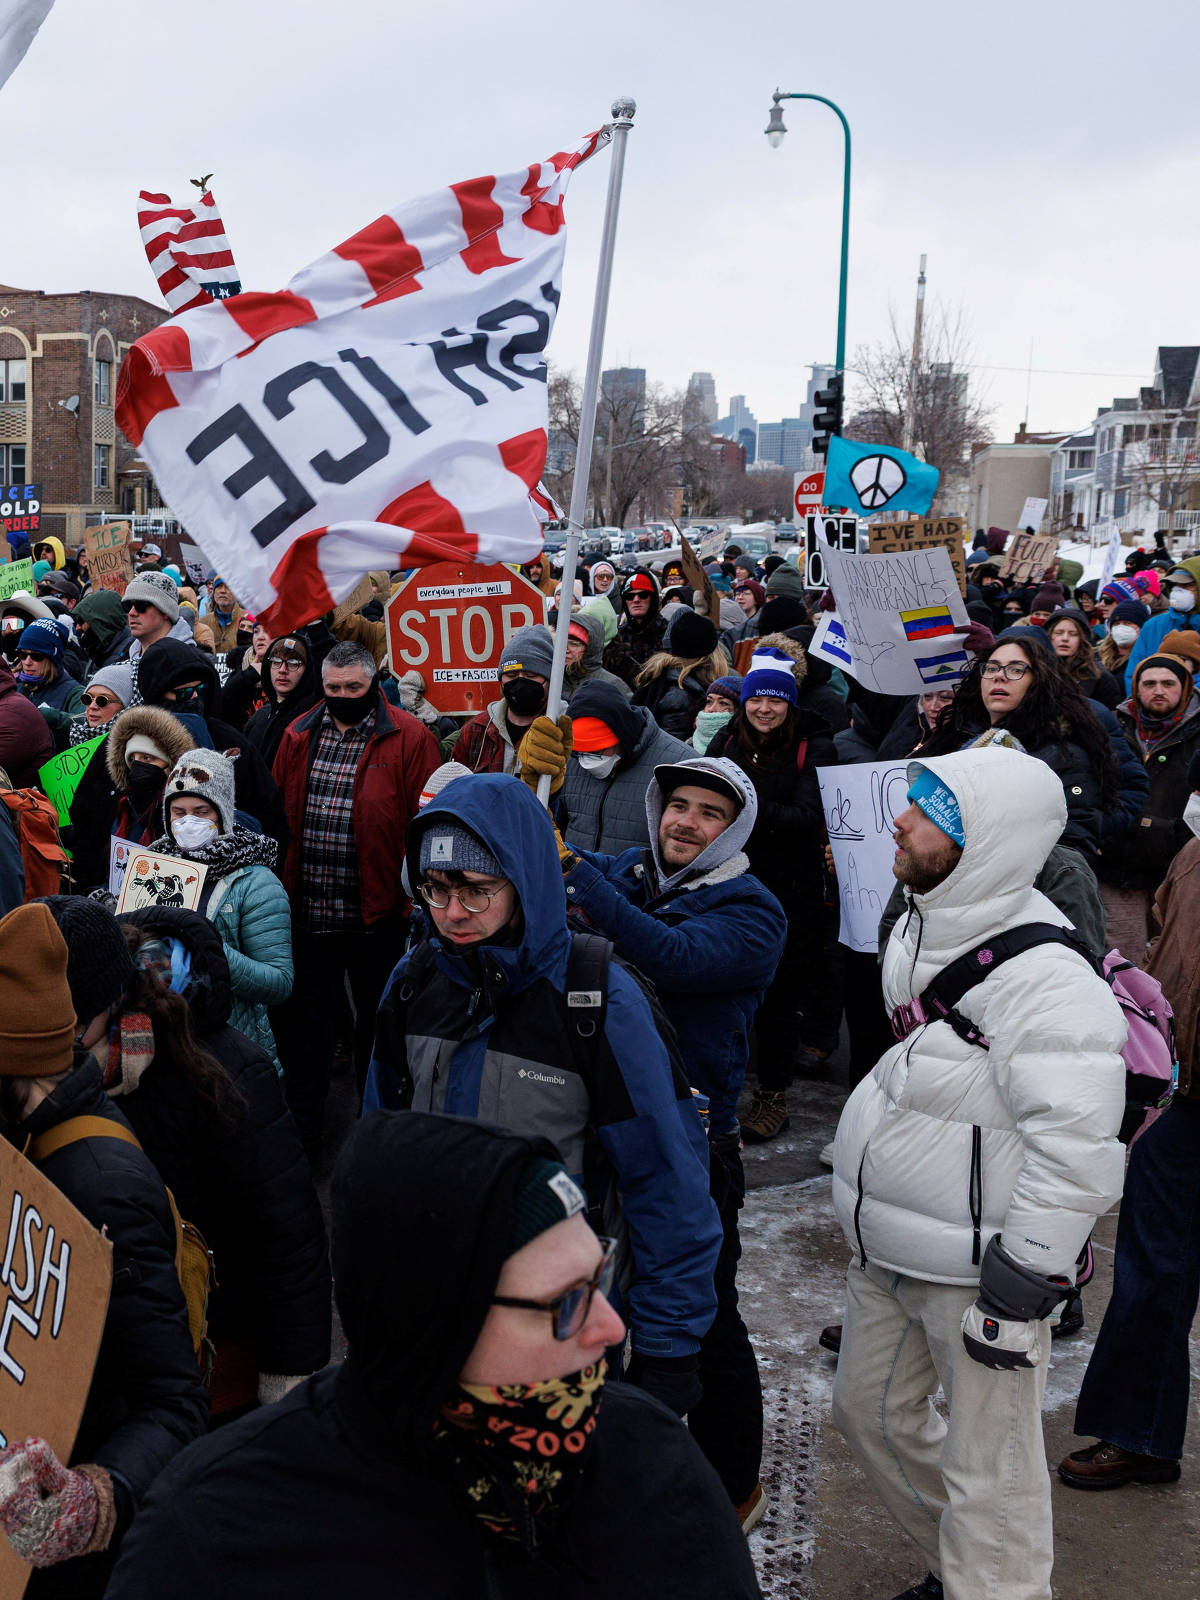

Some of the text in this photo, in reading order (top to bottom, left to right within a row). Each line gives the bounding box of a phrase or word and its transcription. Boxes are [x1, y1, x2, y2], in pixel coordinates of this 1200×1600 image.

[803, 482, 817, 492] DO
[93, 526, 123, 551] ICE
[872, 522, 959, 541] I'VE HAD
[841, 552, 936, 588] IGNORANCE
[419, 584, 503, 599] everyday people will
[849, 580, 947, 611] IMMIGRANTS
[399, 604, 534, 666] STOP
[435, 671, 453, 681] ICE
[462, 669, 499, 681] FASCIS
[55, 747, 90, 781] STOP
[933, 785, 947, 799] WE
[918, 796, 955, 834] NEIGHBORS
[928, 795, 957, 822] SOMALI
[527, 1070, 565, 1085] Columbia
